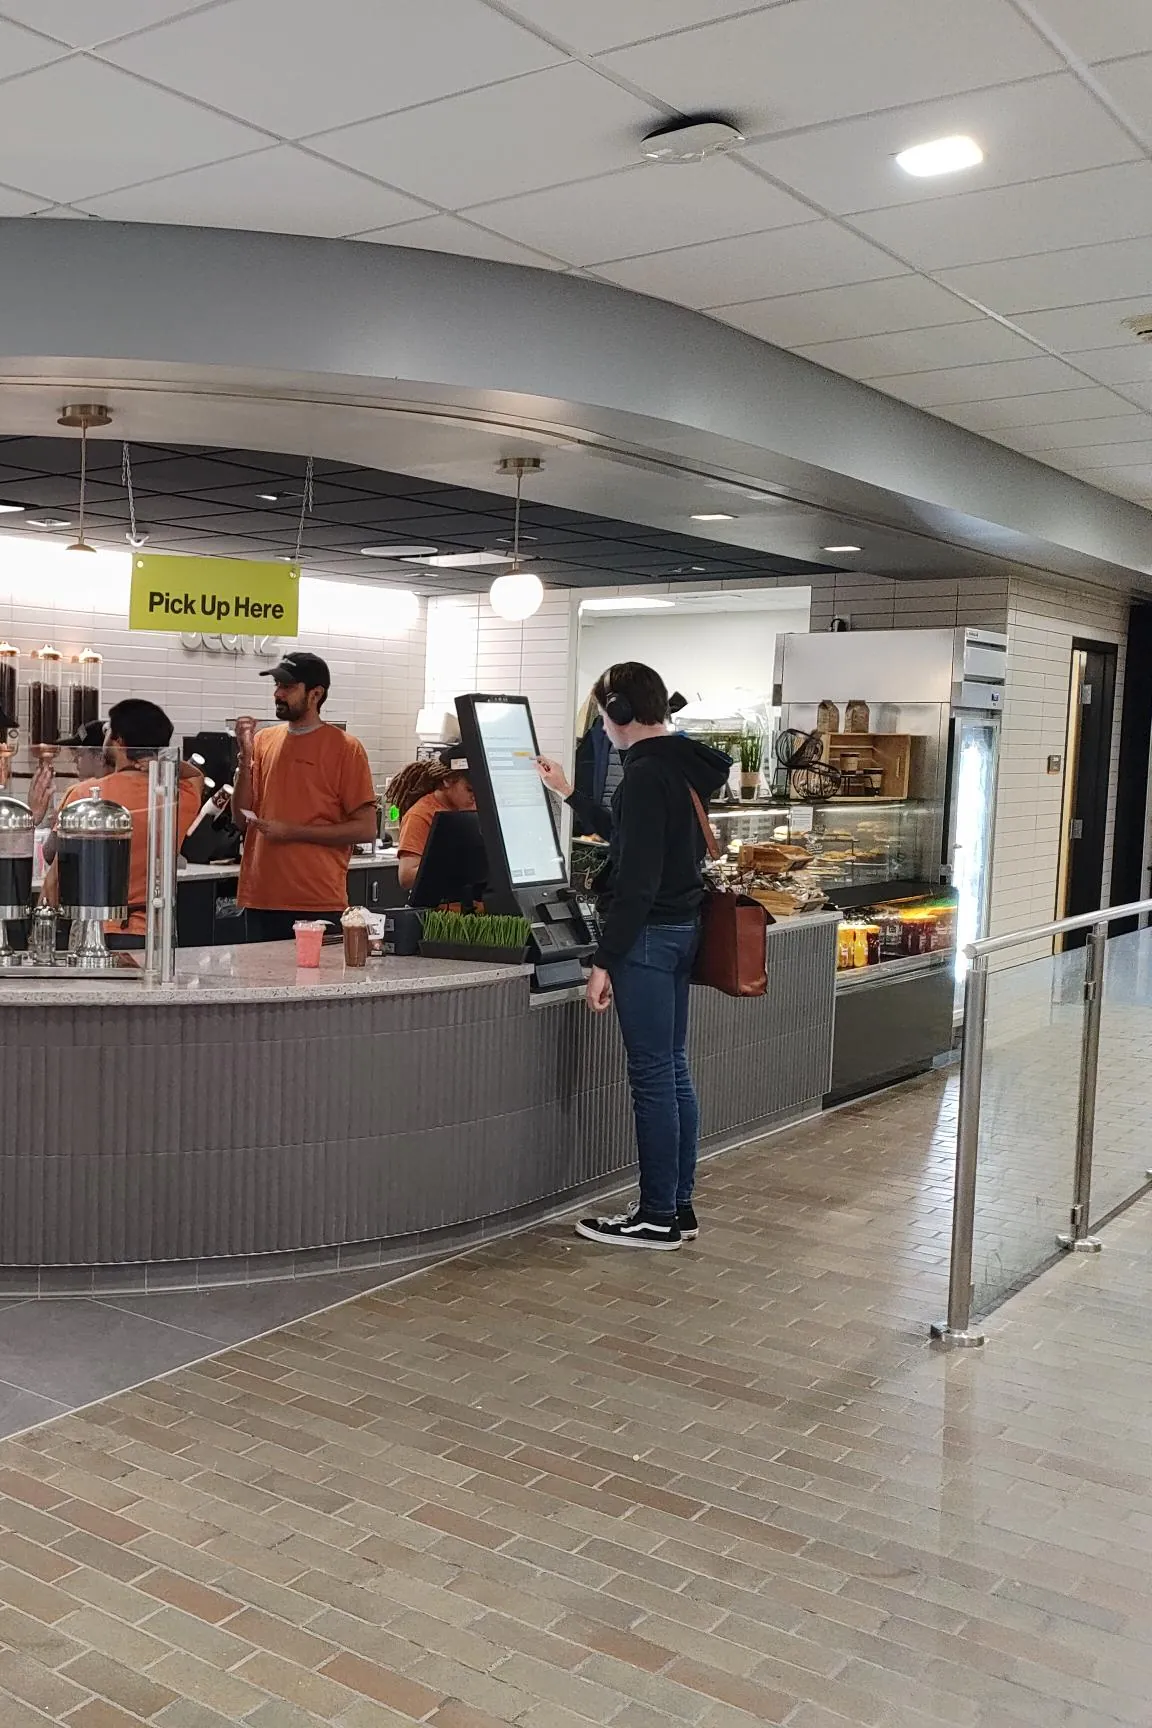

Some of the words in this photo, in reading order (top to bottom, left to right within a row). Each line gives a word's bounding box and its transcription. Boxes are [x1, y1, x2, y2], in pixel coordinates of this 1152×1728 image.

[149, 591, 196, 615] Pick
[201, 594, 230, 620] Up
[234, 596, 284, 619] Here
